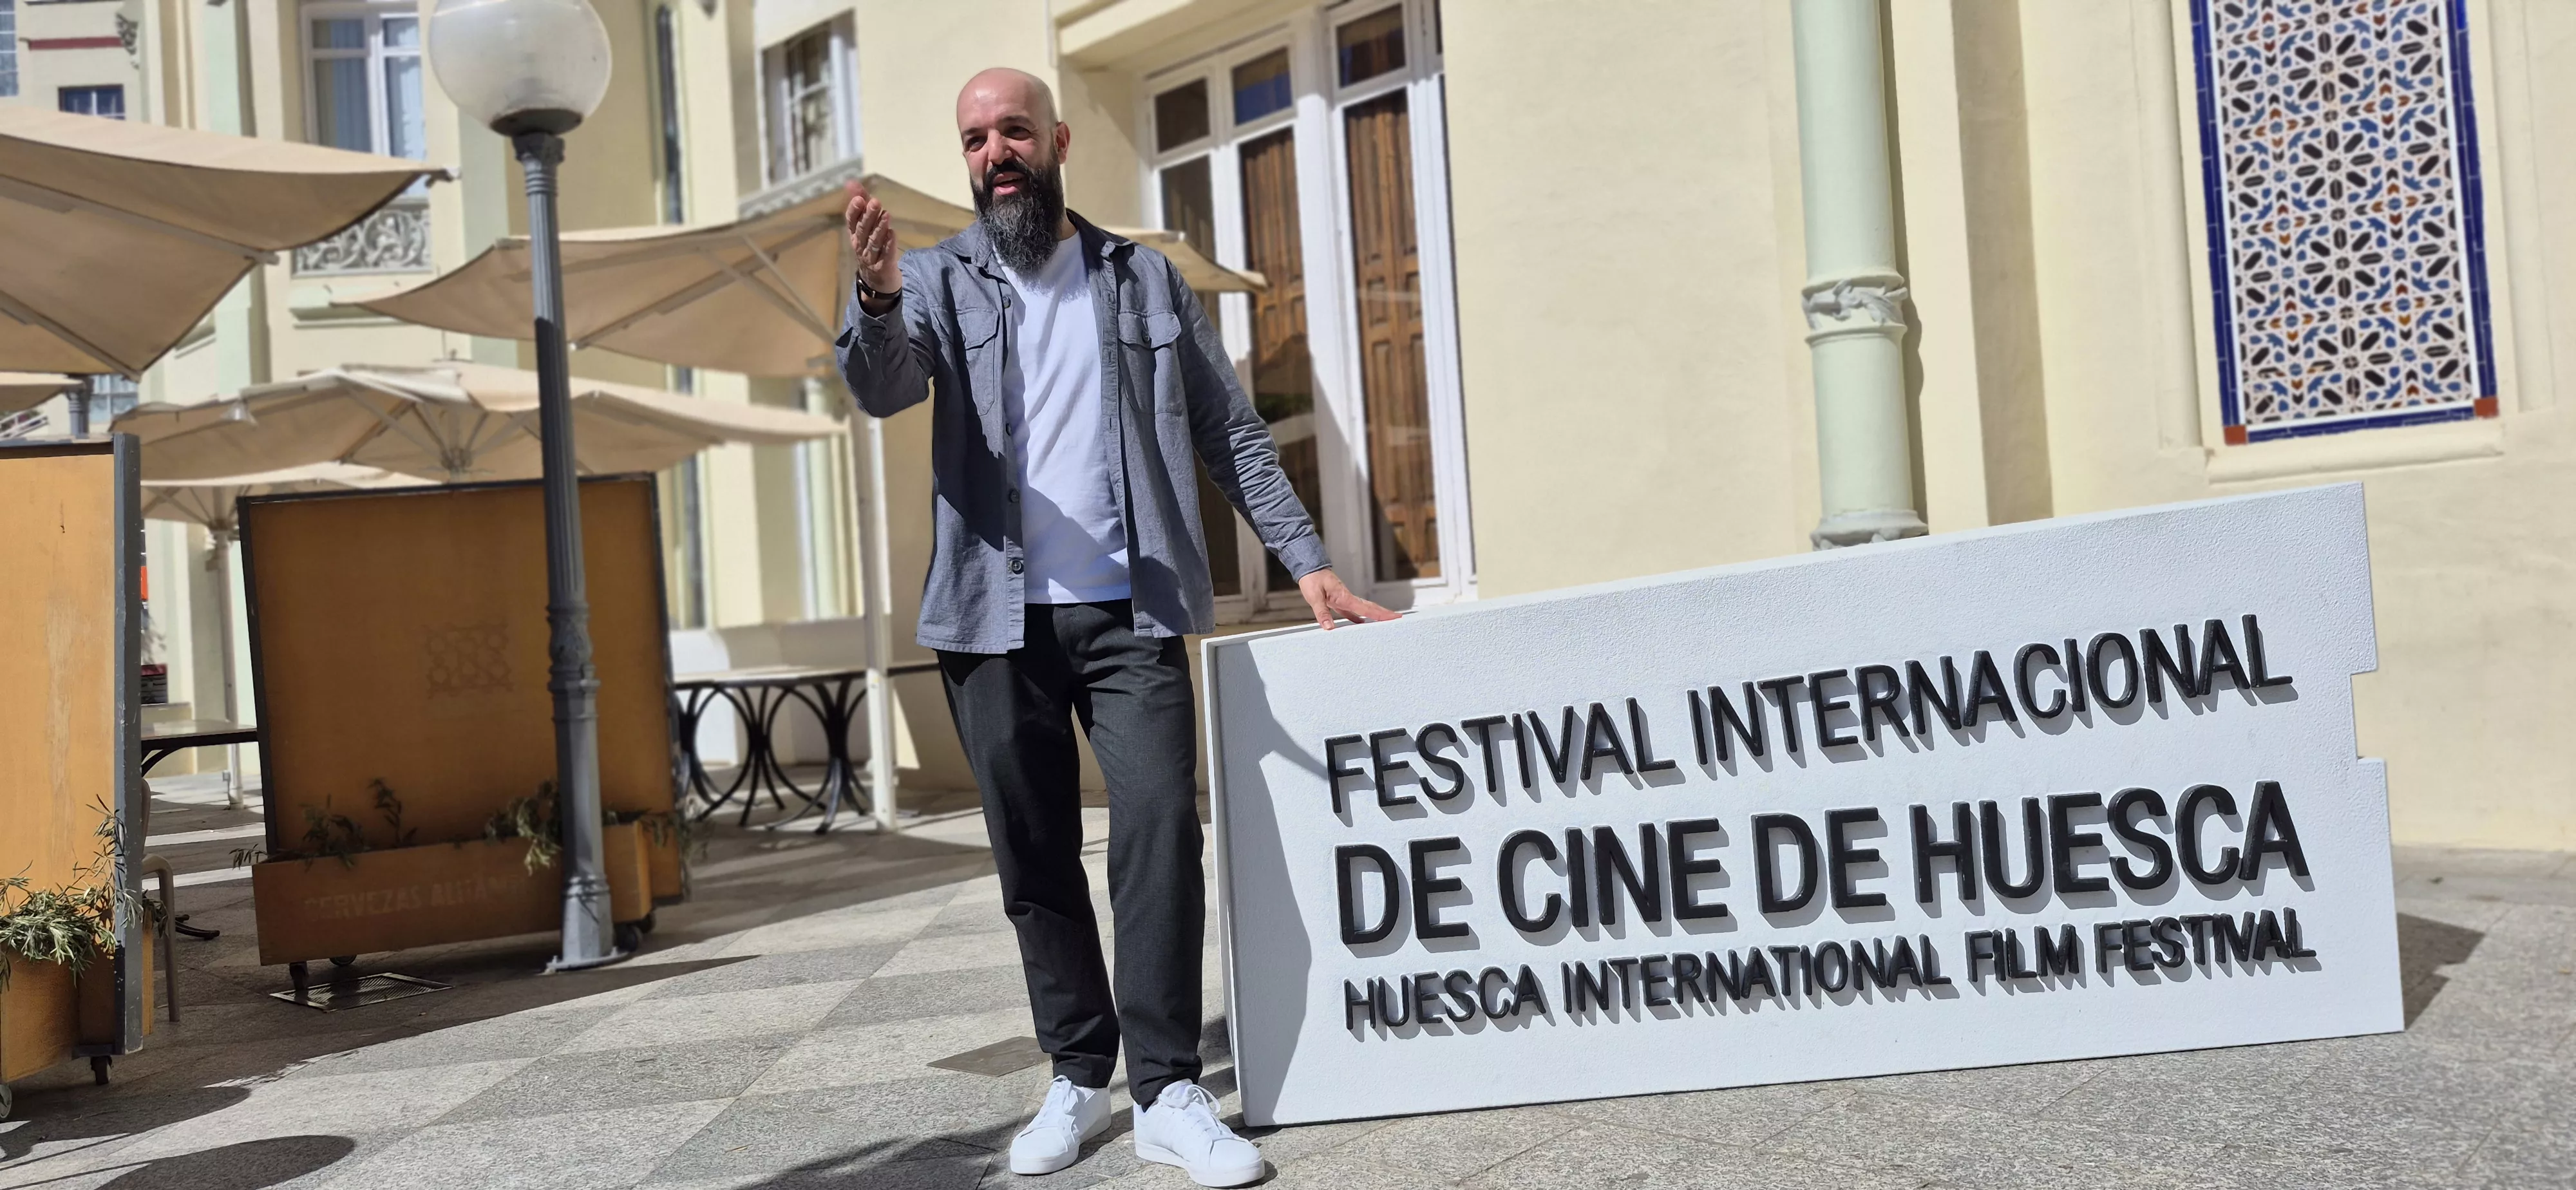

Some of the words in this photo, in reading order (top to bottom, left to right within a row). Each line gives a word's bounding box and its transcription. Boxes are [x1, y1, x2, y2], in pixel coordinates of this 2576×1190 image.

[1324, 697, 1677, 815] FESTIVAL
[1687, 613, 2294, 766] INTERNACIONAL
[1334, 835, 1471, 947] DE
[1497, 817, 1730, 934] CINE
[1751, 806, 1888, 914] DE
[1908, 780, 2311, 904] HUESCA
[1343, 964, 1548, 1032] HUESCA
[1560, 934, 1953, 1015] INTERNATIONAL
[1964, 923, 2081, 983] FILM
[2093, 907, 2317, 974] FESTIVAL
